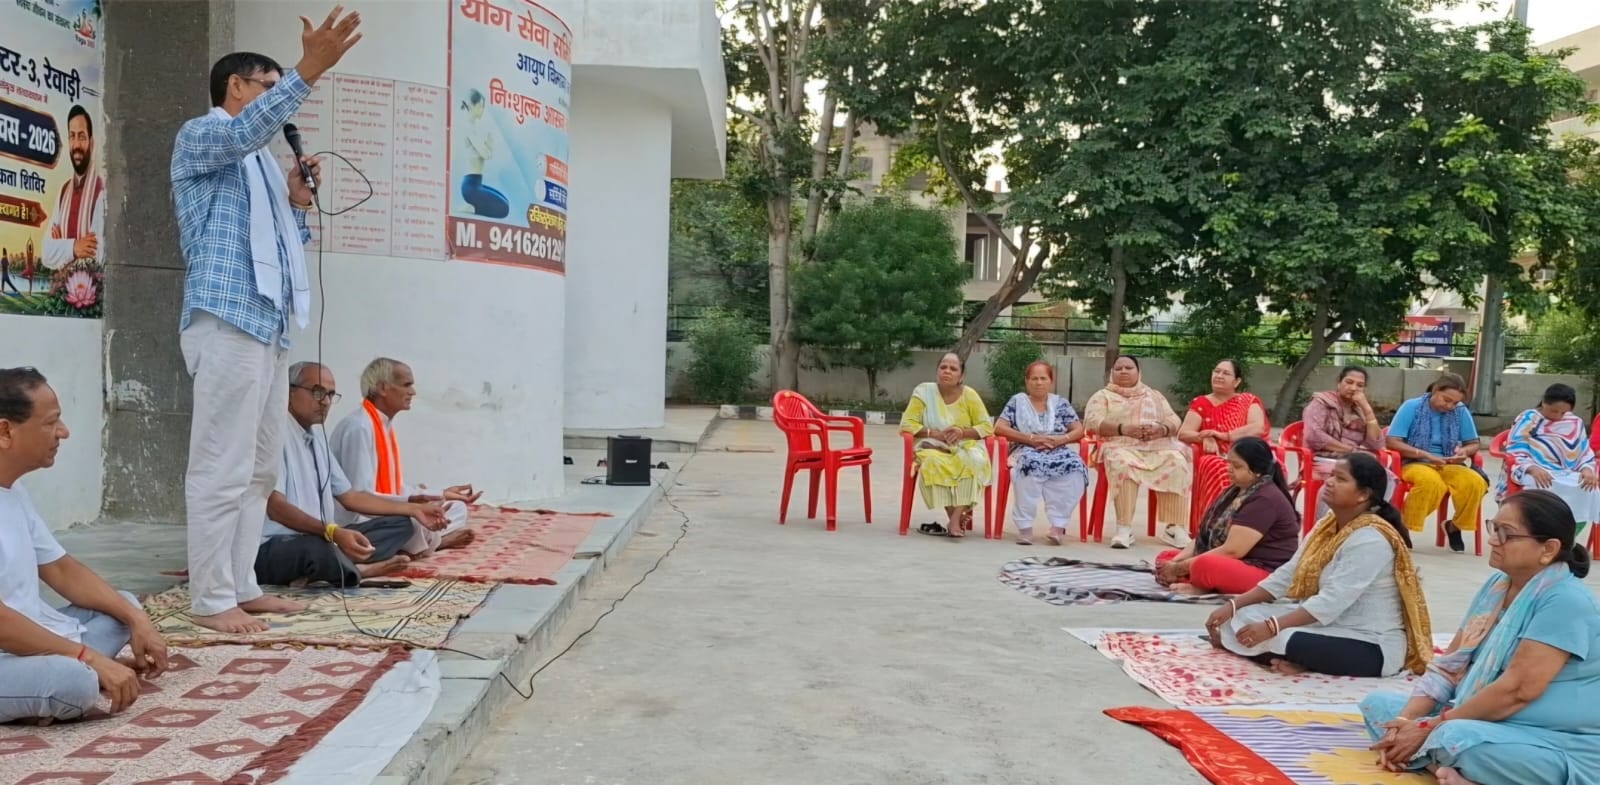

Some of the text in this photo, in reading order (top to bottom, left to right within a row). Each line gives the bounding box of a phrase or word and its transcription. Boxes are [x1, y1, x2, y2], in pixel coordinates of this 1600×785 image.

[517, 9, 551, 49] सेवा
[43, 56, 82, 103] रेवाड़ी
[20, 168, 46, 194] शिविर
[456, 221, 483, 249] M.
